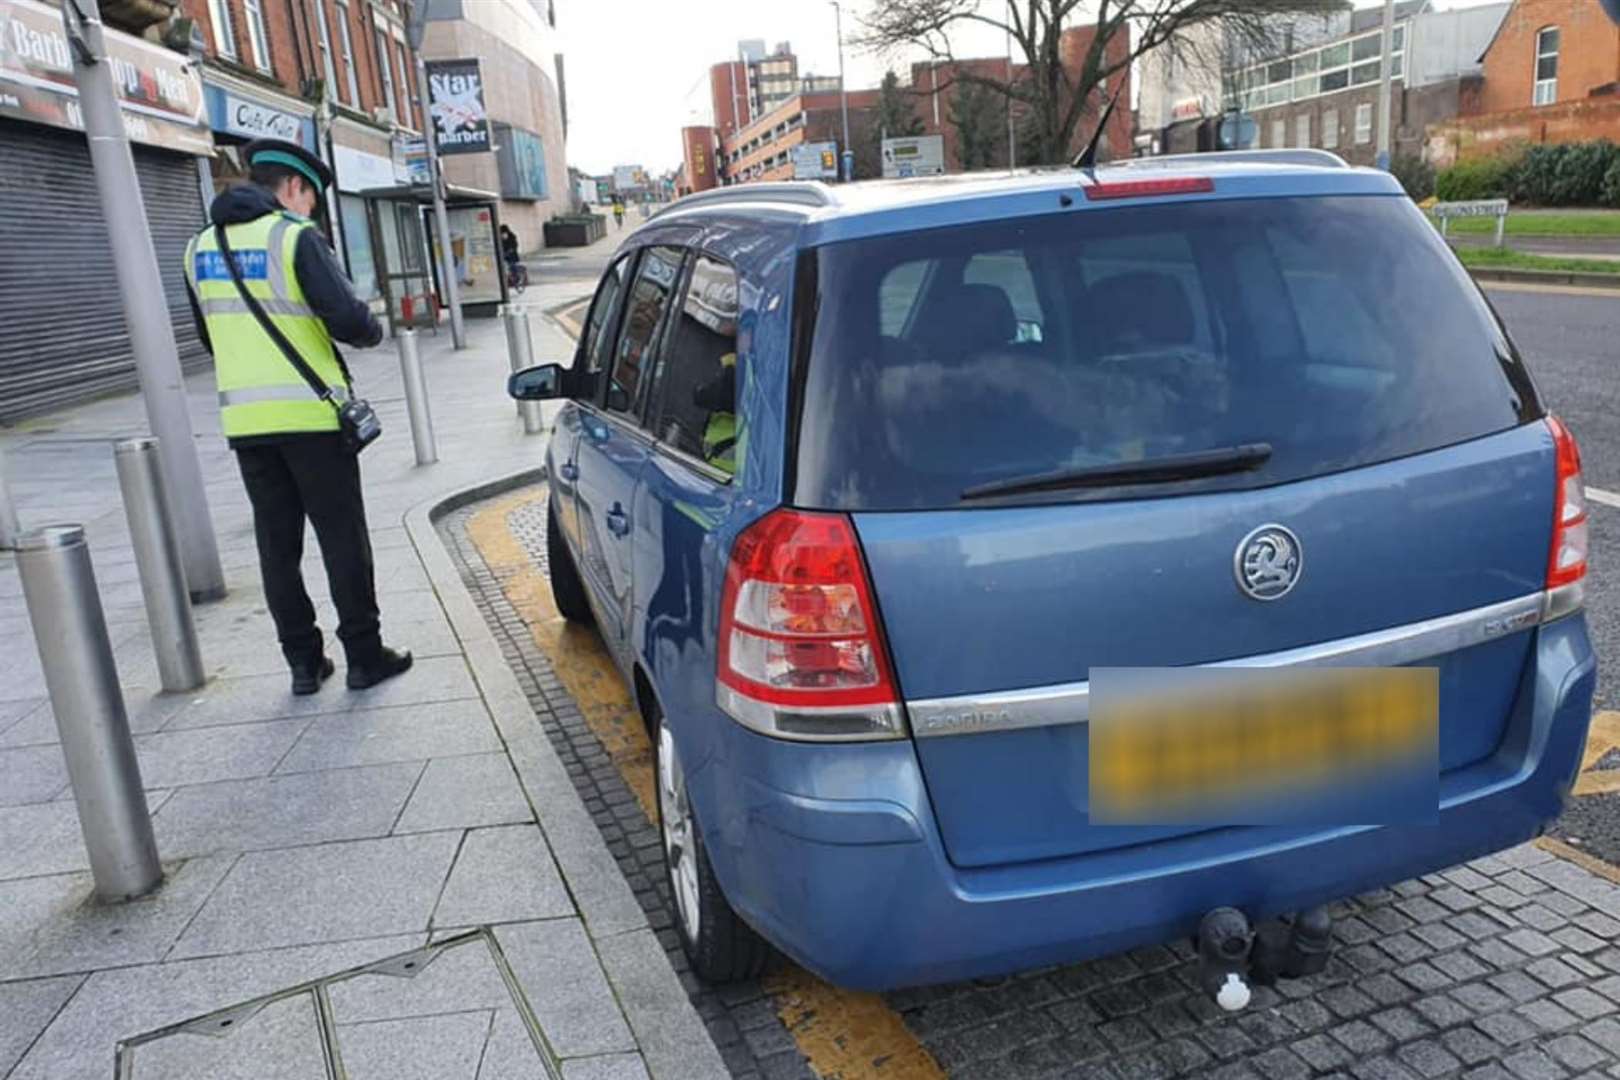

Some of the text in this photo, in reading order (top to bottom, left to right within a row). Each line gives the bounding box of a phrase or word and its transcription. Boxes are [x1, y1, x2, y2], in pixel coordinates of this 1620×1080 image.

[13, 20, 73, 71] Barb
[430, 74, 479, 95] Star
[438, 130, 487, 145] Barber
